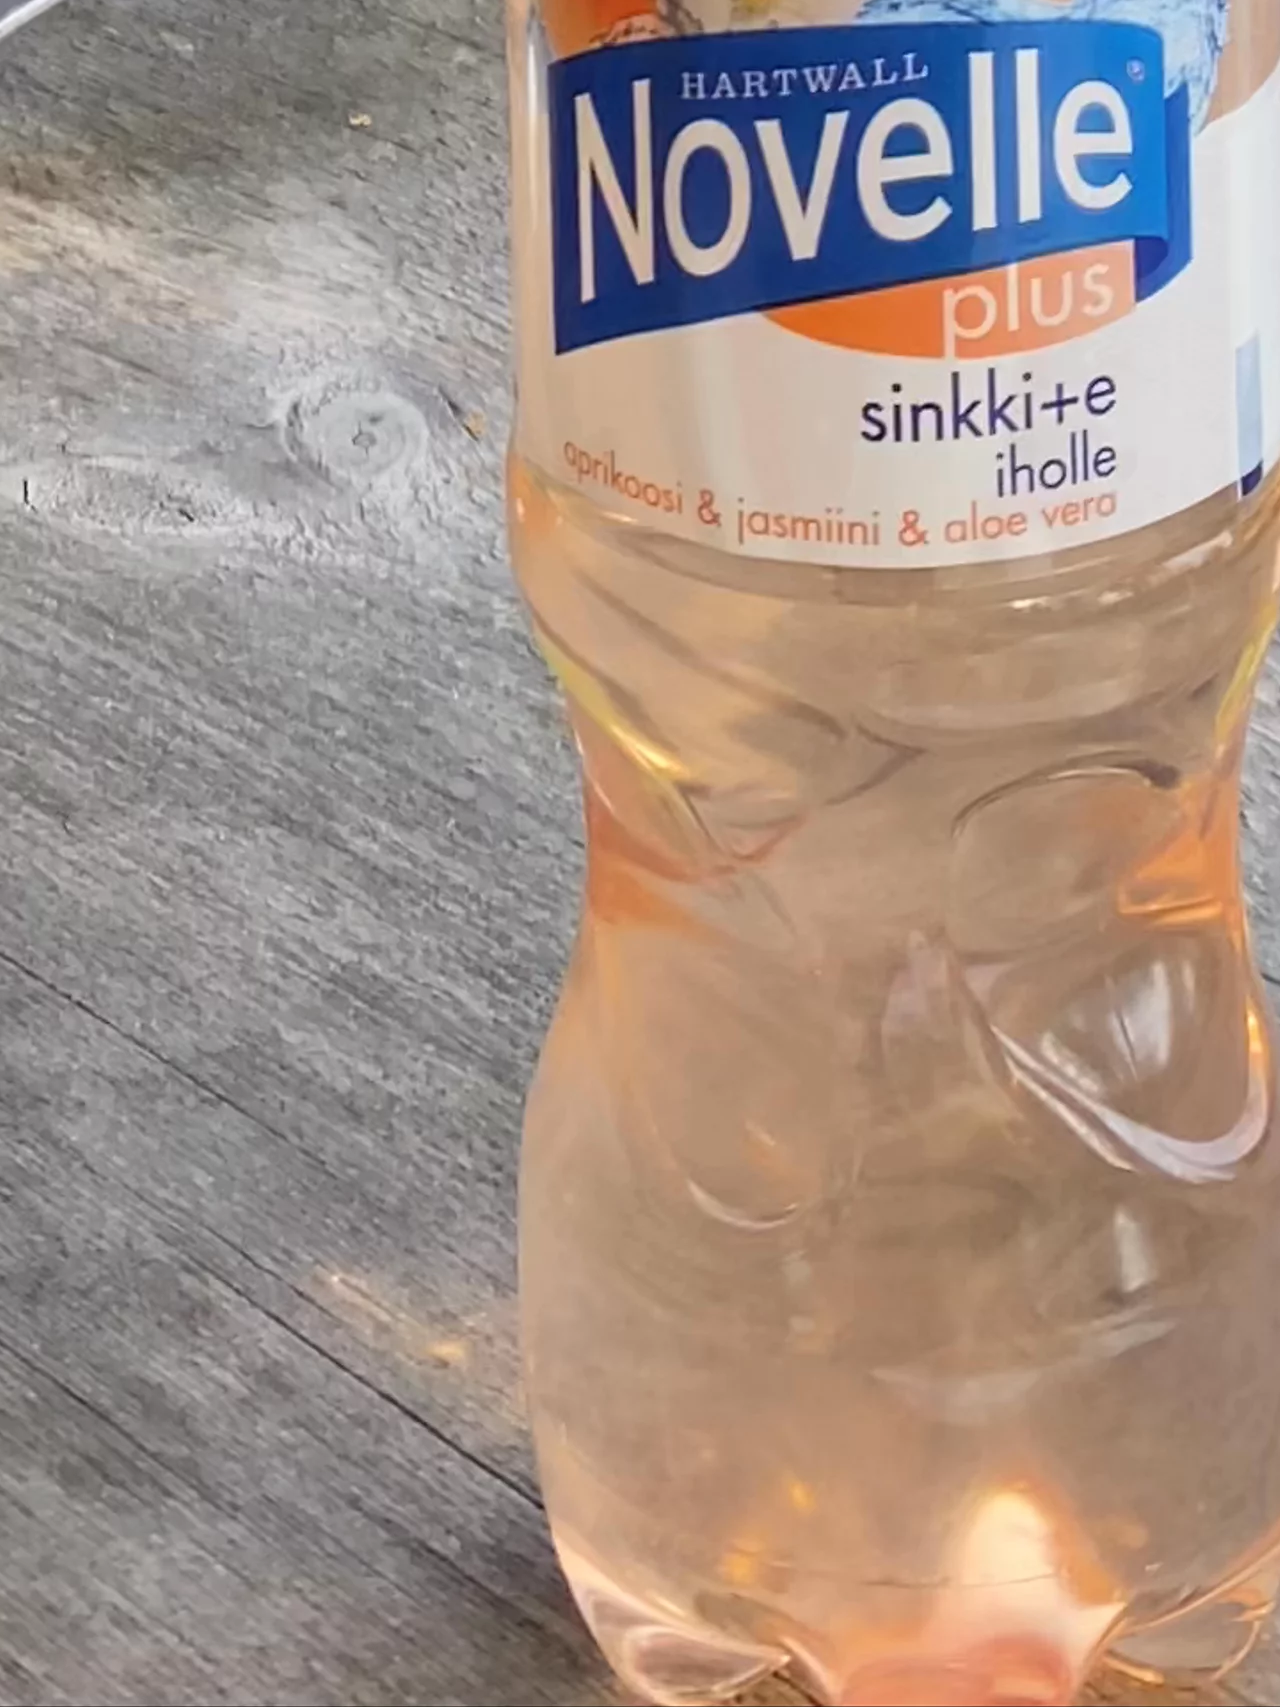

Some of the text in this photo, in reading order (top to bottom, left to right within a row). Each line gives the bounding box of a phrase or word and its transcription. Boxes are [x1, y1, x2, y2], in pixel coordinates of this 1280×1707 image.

[682, 50, 929, 101] HARTWALL
[573, 48, 1134, 304] Novelle
[943, 262, 1114, 360] plus
[859, 366, 1118, 444] sinkki+e
[563, 438, 1118, 548] aprikoosi & jasmiini & aloe vera
[995, 429, 1118, 498] iholle
